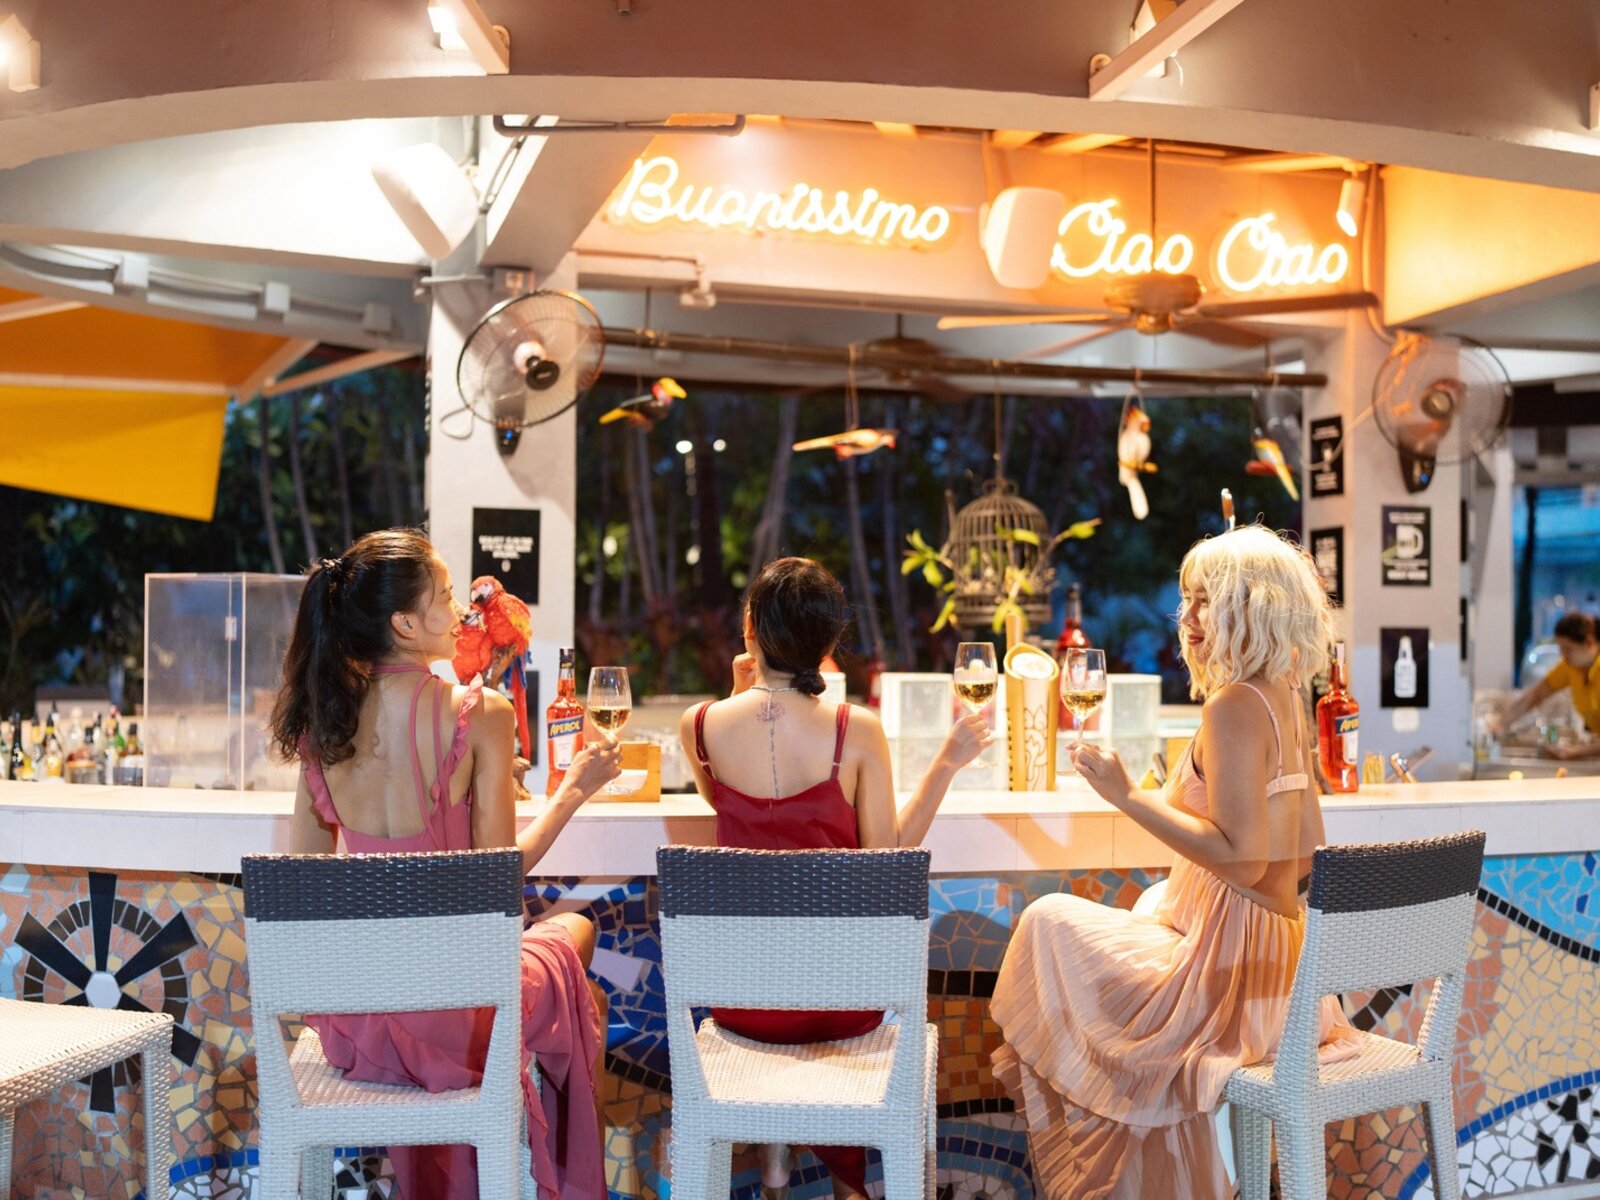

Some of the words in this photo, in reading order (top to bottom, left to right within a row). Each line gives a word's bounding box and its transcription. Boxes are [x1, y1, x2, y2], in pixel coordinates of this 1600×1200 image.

[614, 156, 950, 242] Buonissimo
[1050, 198, 1194, 278] Ciao
[1216, 211, 1349, 293] Ciao
